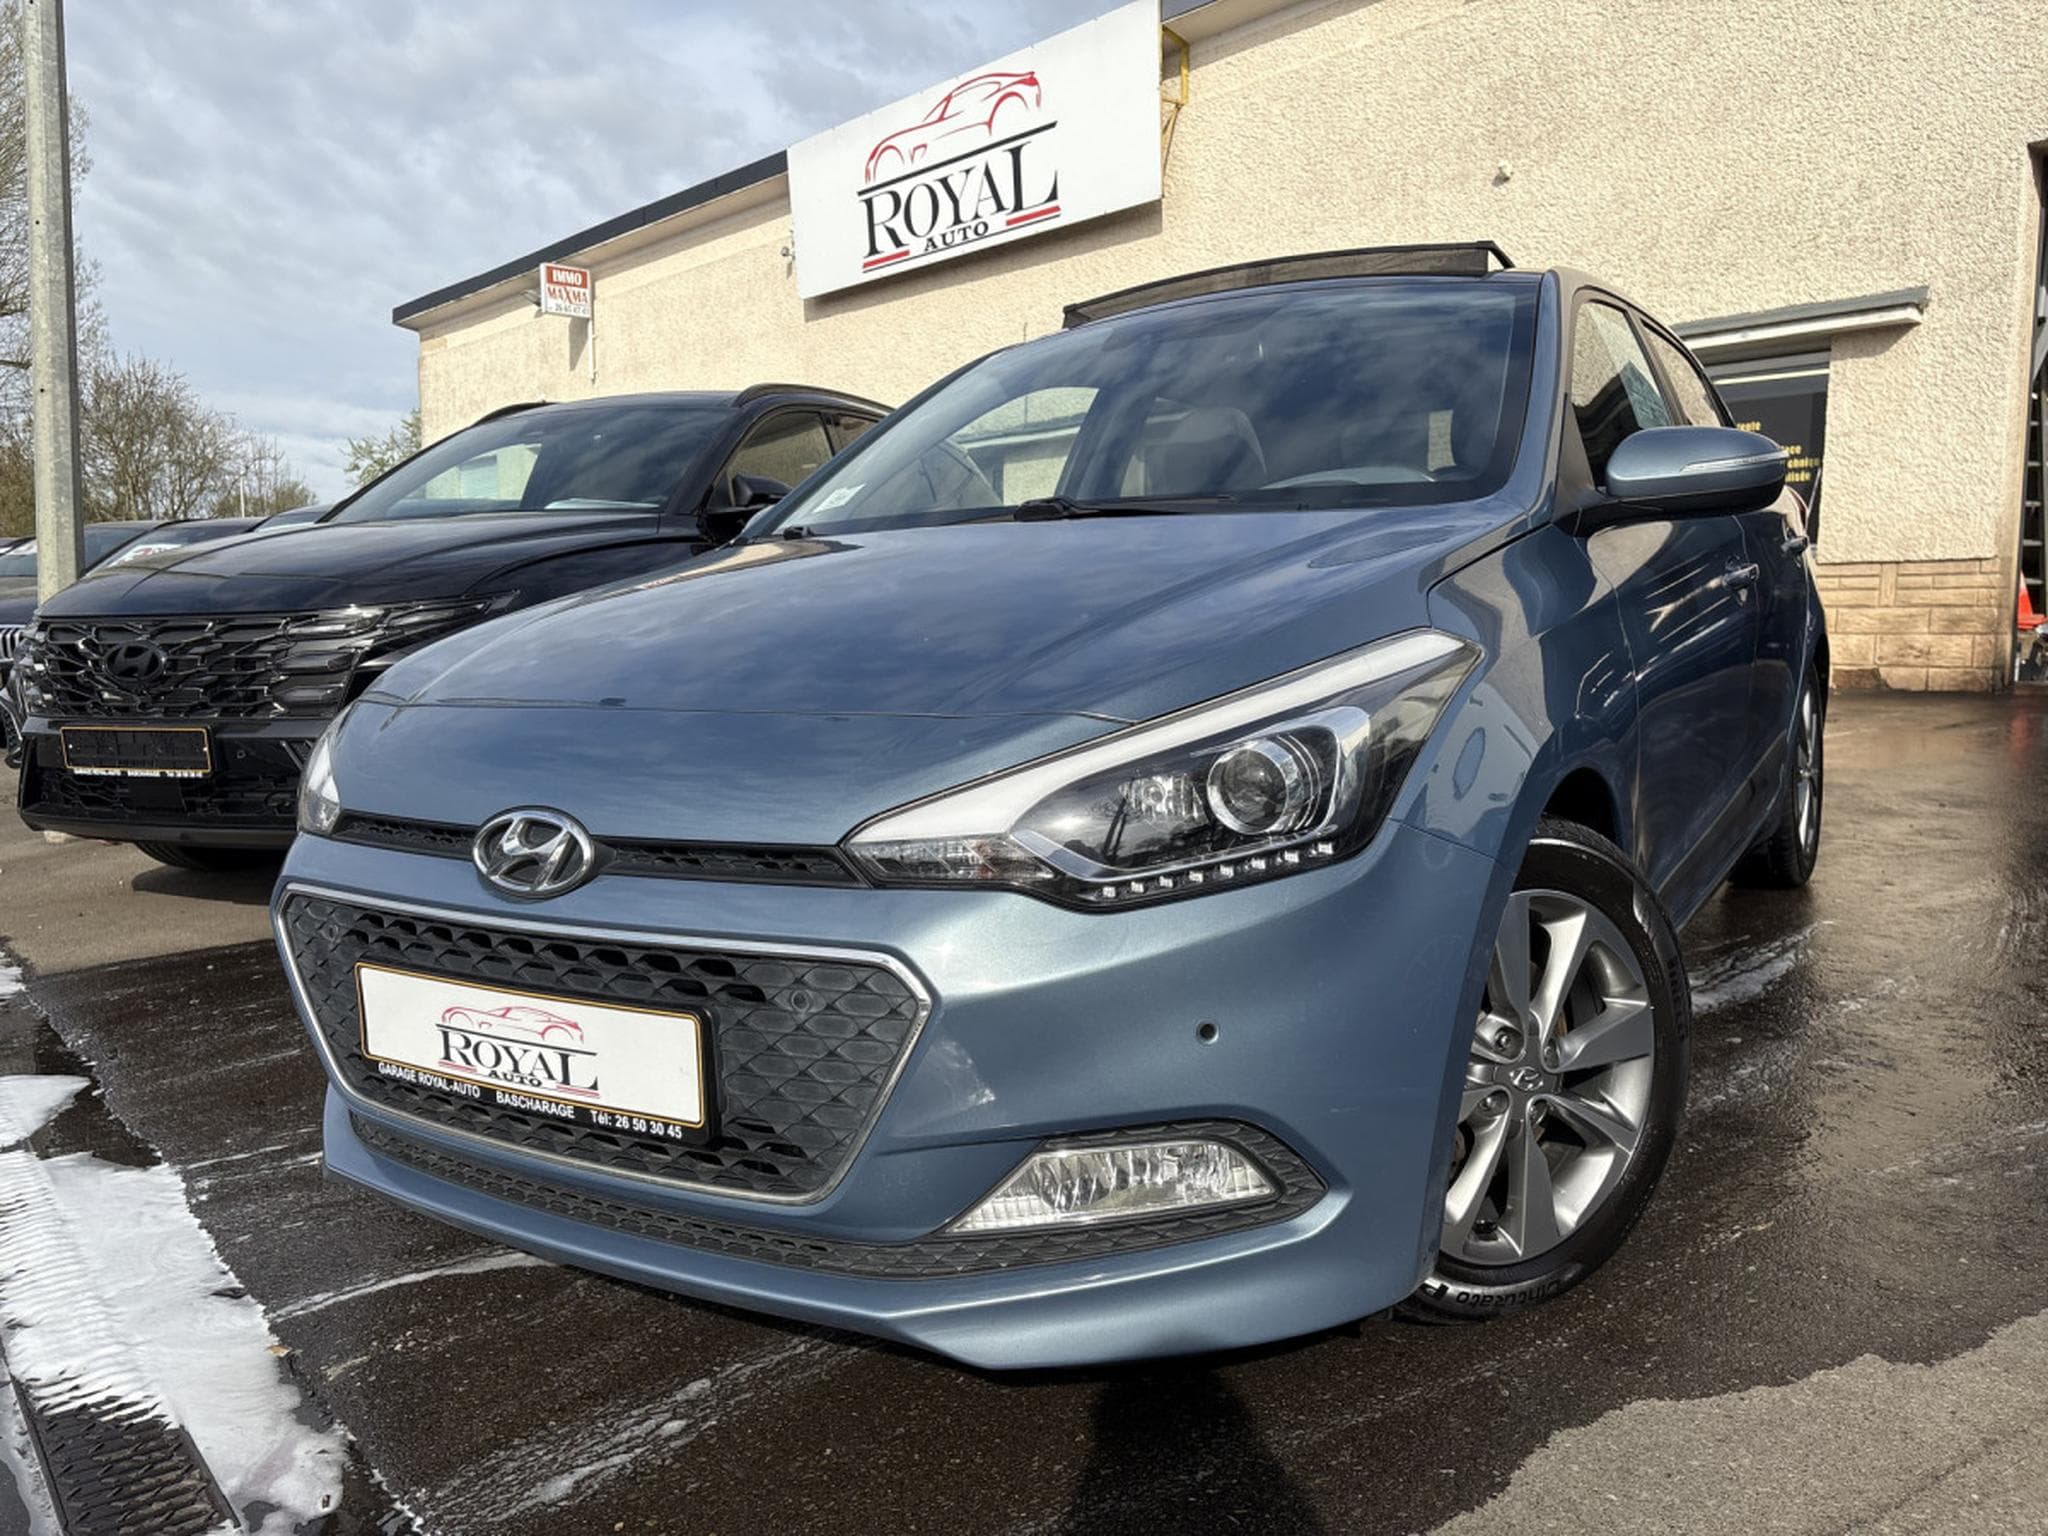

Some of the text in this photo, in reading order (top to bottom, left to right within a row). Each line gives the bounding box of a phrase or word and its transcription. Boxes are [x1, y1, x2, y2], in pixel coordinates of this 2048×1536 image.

[858, 141, 1058, 258] ROYAL
[922, 221, 989, 252] AUTO
[552, 269, 582, 286] IMMO
[438, 1030, 599, 1091] ROYAL
[488, 1069, 543, 1088] AUTO
[378, 1062, 682, 1139] GARAGE ROYAL-AUTO BASCHARAGE Tél: 26 50 30 45
